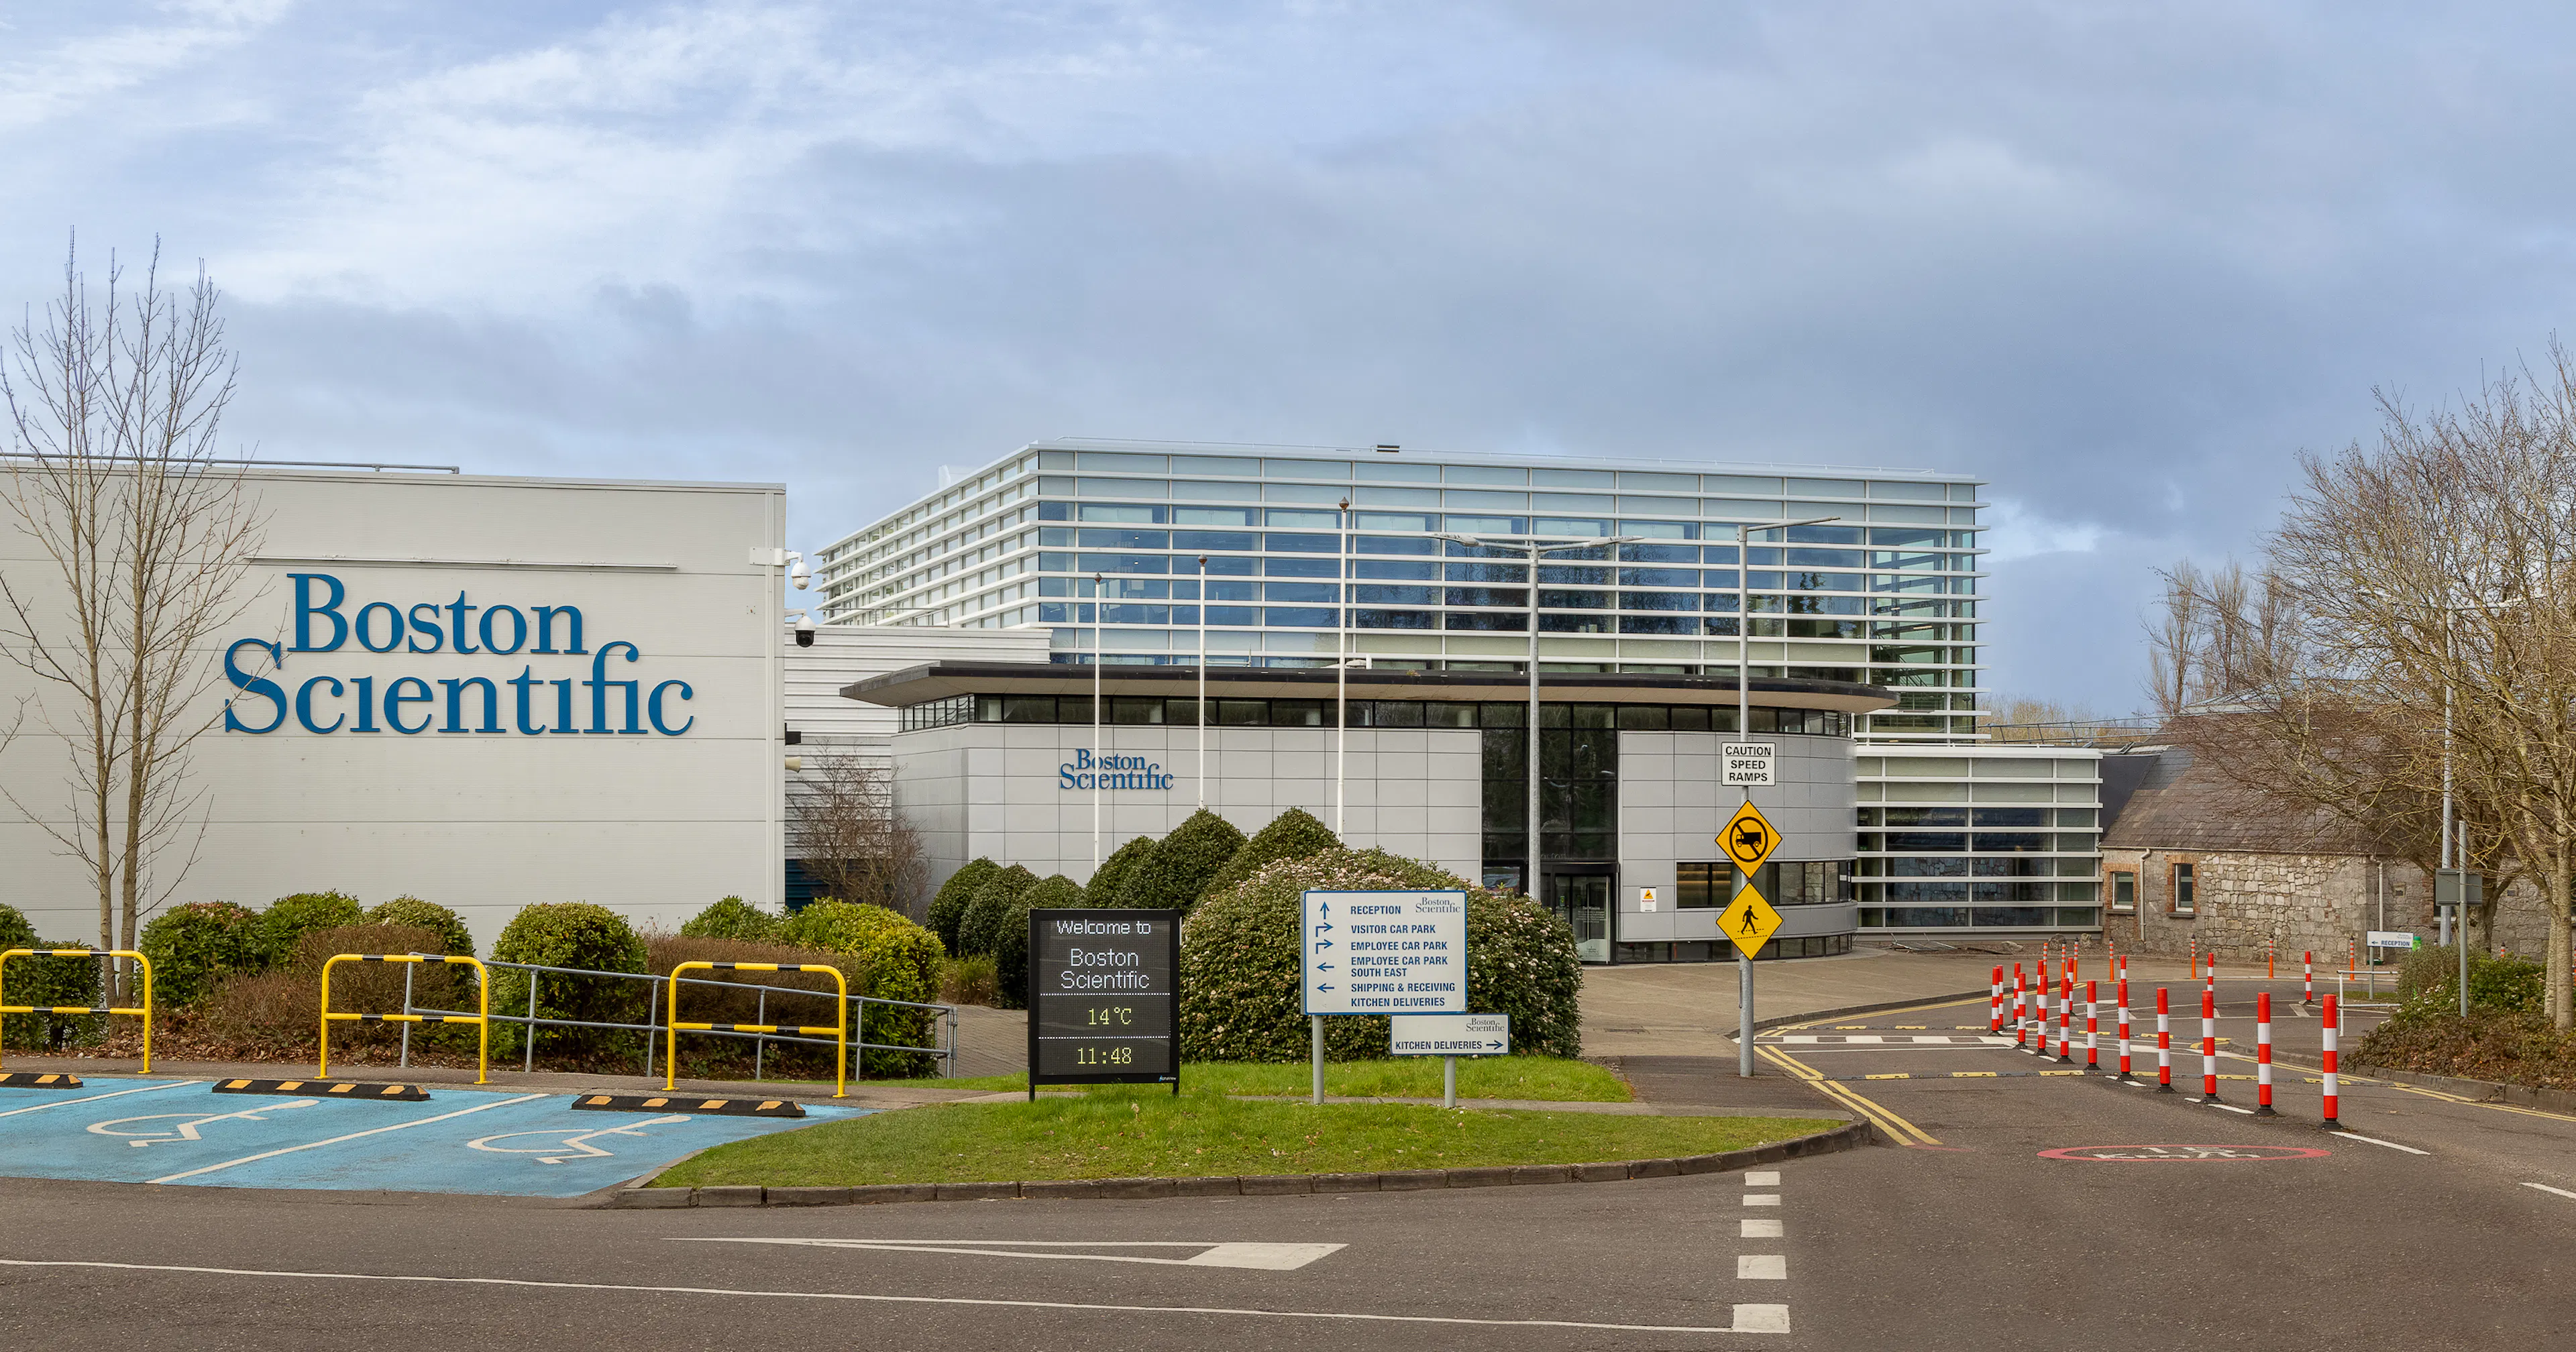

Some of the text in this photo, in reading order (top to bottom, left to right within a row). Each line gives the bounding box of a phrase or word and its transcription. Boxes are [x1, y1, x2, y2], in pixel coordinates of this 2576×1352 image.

[286, 573, 588, 655] Boston
[224, 638, 694, 736] Scientific
[1725, 746, 1771, 756] CAUTION
[1075, 748, 1146, 770] Boston
[1731, 760, 1766, 769] SPEED
[1060, 763, 1174, 790] Scientific
[1729, 772, 1768, 781] RAMPS
[1421, 897, 1450, 906] Boston
[1350, 905, 1401, 915] RECEPTION
[1415, 902, 1460, 913] Scientific
[1057, 919, 1152, 935] Welcome to
[1351, 924, 1436, 934] VISITOR CAR PARK
[1350, 941, 1448, 951] EMPLOYEE CAR PARK
[1070, 948, 1139, 966] Boston
[1350, 956, 1448, 966] EMPLOYEE CAR PARK
[1351, 968, 1407, 977] SOUTH EAST
[1061, 970, 1150, 989] Scientific
[1351, 982, 1455, 993] SHIPPING & RECEIVING
[1351, 997, 1445, 1007] KITCHEN DELIVERIES
[1471, 1017, 1495, 1025] Boston
[1466, 1023, 1505, 1032] Scientific
[1395, 1041, 1482, 1050] KITCHEN DELIVERIES
[1077, 1048, 1132, 1064] 11:48
